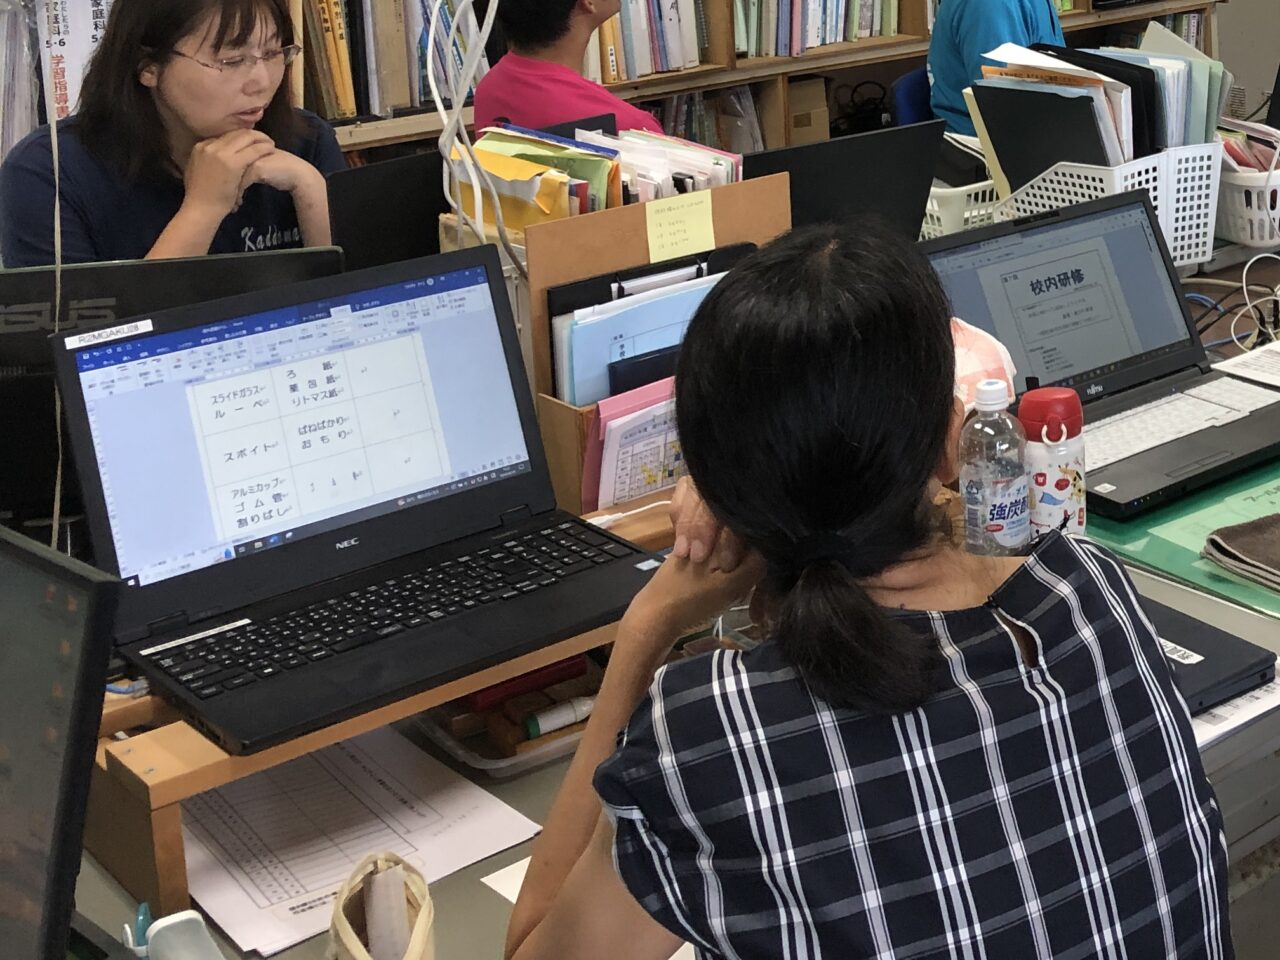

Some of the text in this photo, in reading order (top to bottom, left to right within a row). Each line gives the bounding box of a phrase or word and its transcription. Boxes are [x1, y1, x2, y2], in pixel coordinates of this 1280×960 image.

[1029, 268, 1085, 296] 校内研修
[210, 384, 261, 405] スライドガラス
[292, 388, 339, 407] リトマス紙
[298, 415, 345, 436] ばねばかり
[223, 442, 272, 463] スポイト
[231, 476, 281, 500] アルミカップ
[236, 506, 286, 529] 割りばし
[334, 535, 360, 551] NEC
